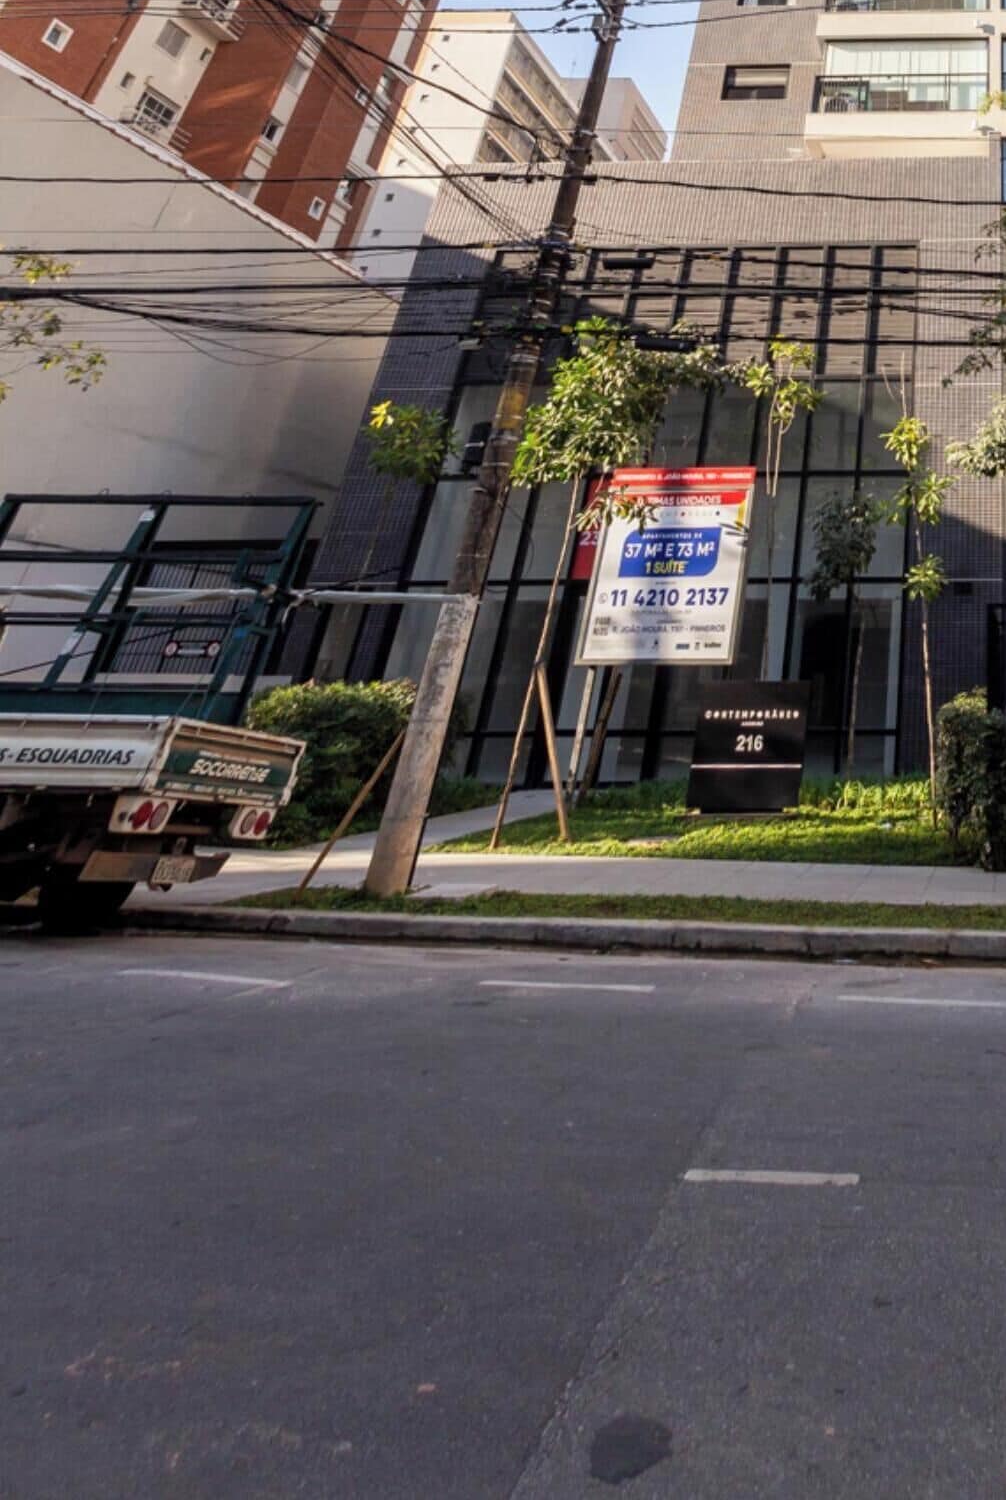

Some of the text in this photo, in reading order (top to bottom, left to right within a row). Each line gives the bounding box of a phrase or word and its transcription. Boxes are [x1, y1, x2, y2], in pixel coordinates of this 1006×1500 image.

[624, 542, 642, 559] 37
[665, 543, 675, 557] E
[677, 542, 694, 558] 73
[654, 559, 687, 573] SUÍTE
[611, 587, 730, 607] 11 4210 2137
[704, 708, 800, 720] CONTEMPORÂNEO
[735, 734, 764, 753] 216
[16, 747, 136, 765] ESQUADRIAS
